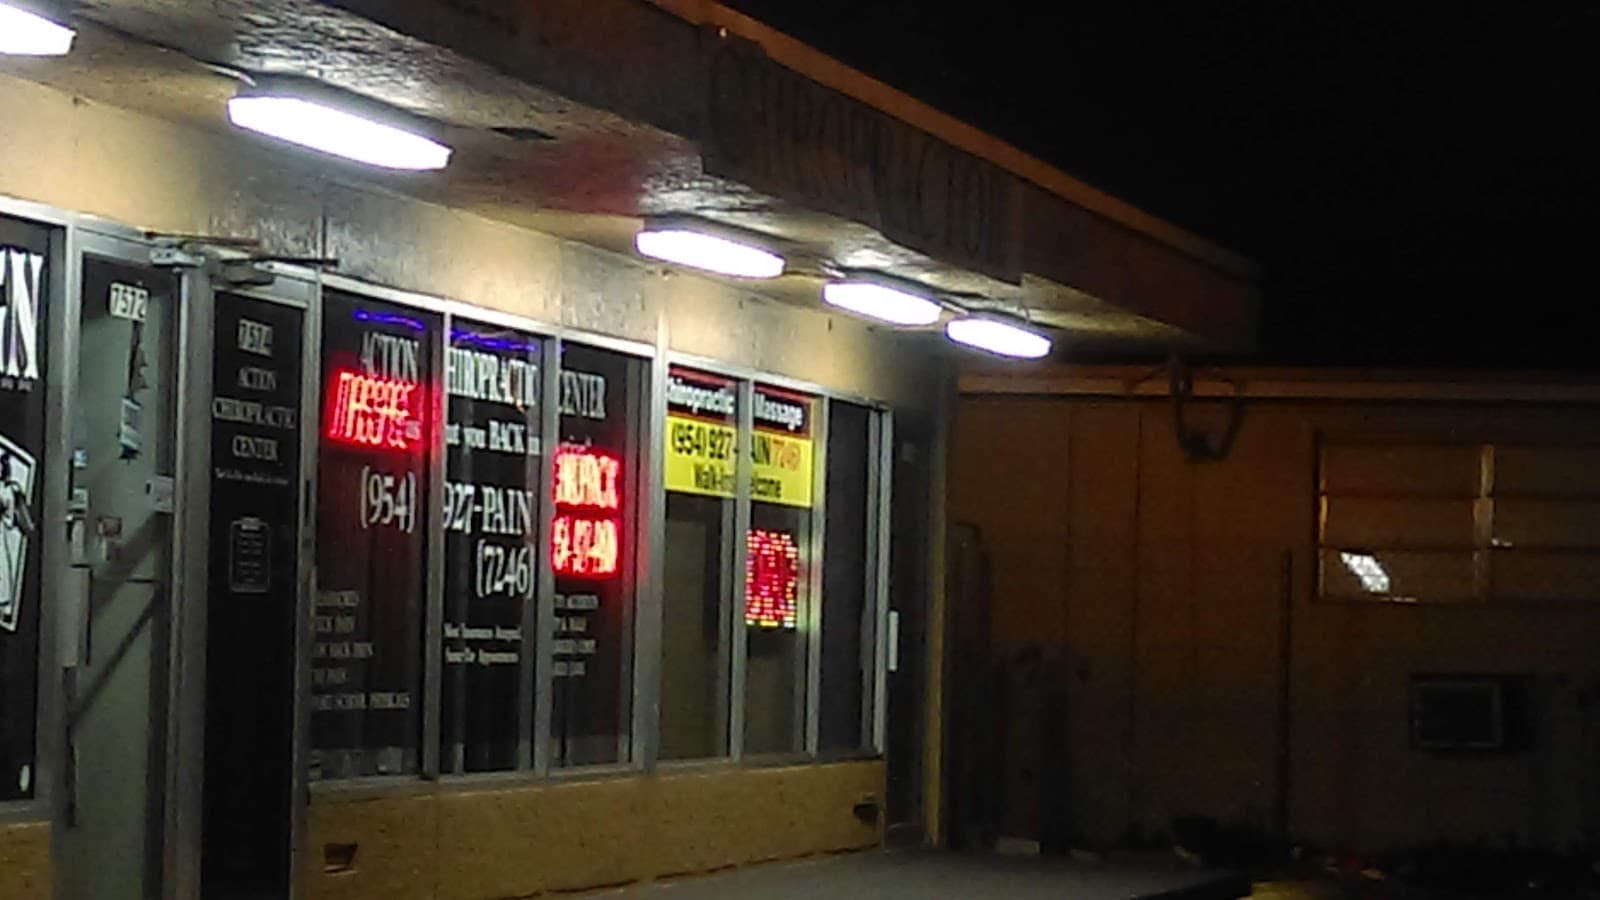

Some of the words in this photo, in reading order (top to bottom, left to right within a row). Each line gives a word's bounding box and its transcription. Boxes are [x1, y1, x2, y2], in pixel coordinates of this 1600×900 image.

[447, 347, 538, 406] HIROPRACTIC
[558, 369, 606, 419] ENTER
[489, 420, 525, 454] BACK
[360, 465, 417, 533] (954)
[476, 539, 535, 599] (7246)
